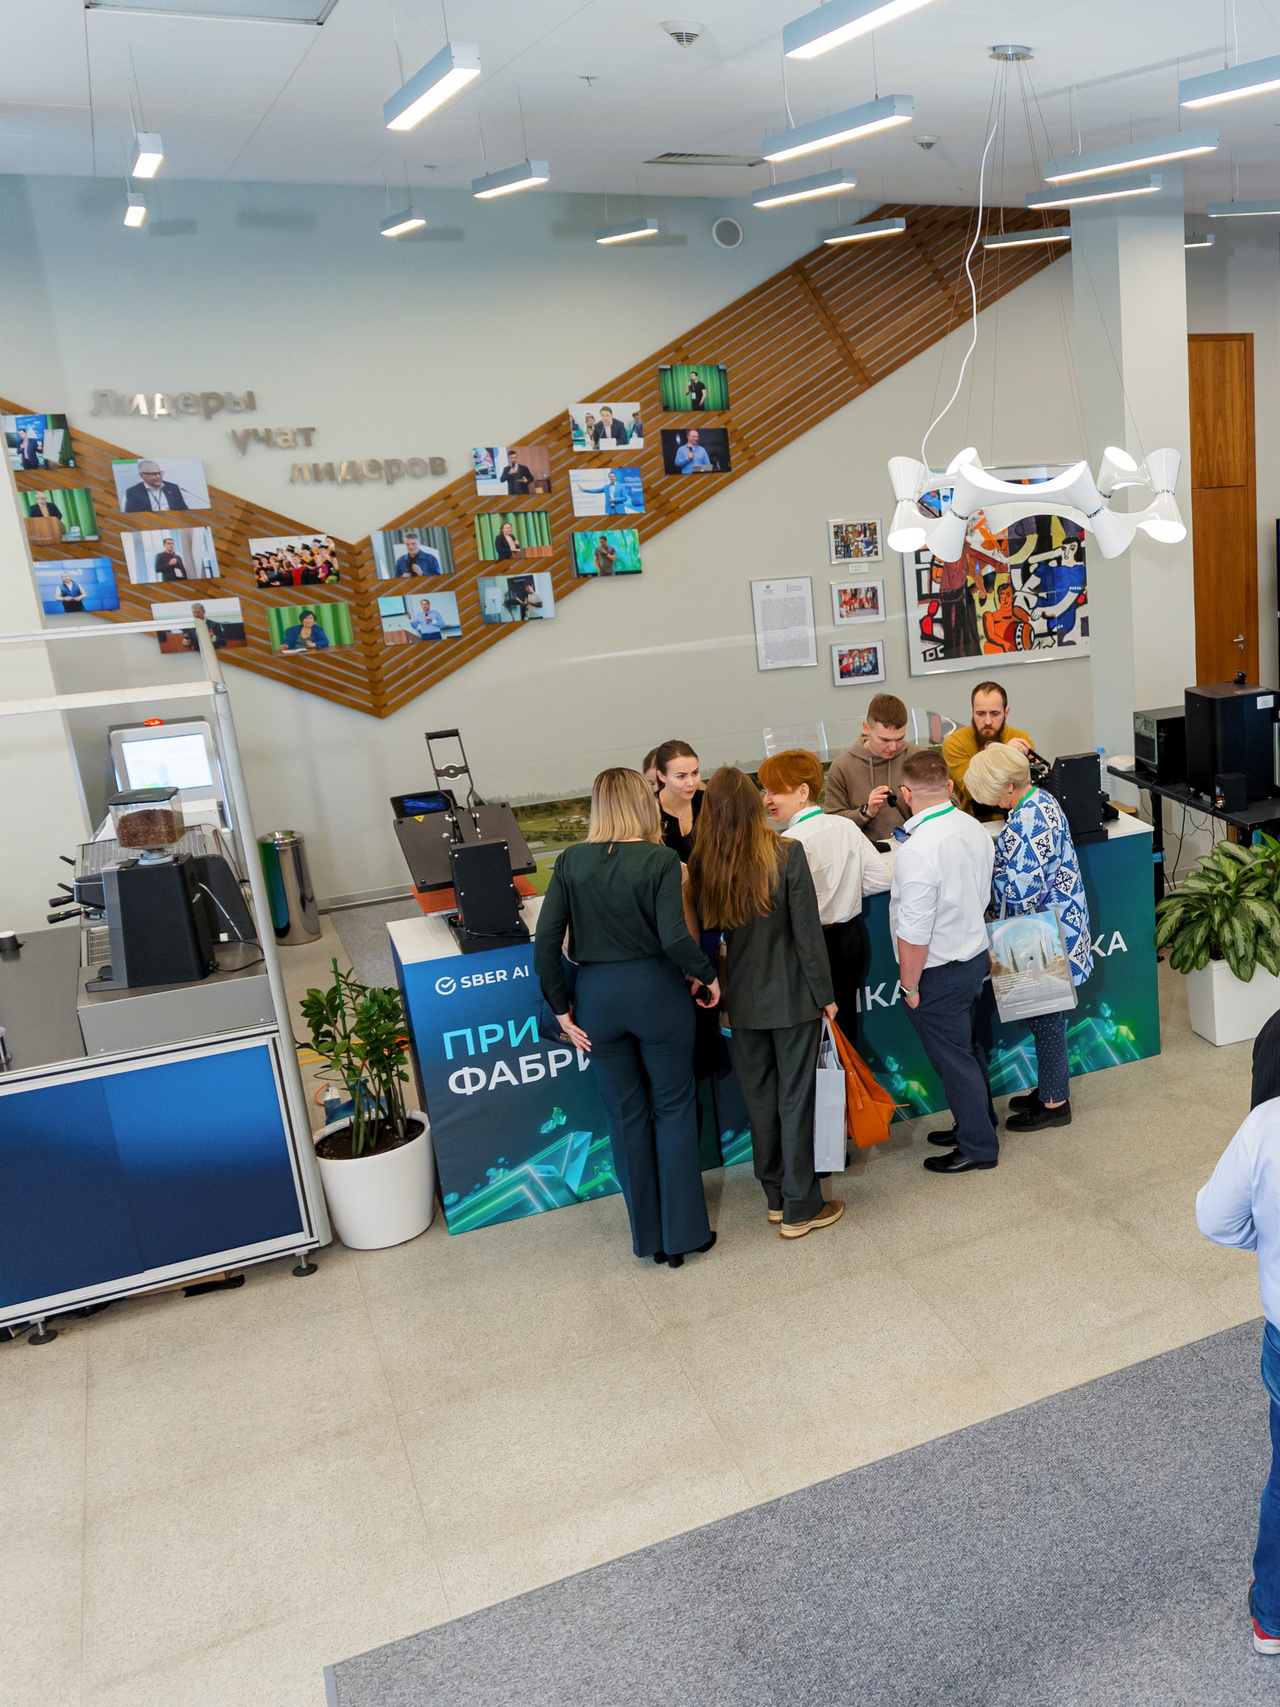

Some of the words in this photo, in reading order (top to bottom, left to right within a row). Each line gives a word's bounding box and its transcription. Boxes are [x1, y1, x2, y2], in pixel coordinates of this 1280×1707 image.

[90, 388, 257, 420] Лидеры
[227, 426, 316, 456] учат
[289, 456, 448, 485] лидеров
[460, 969, 508, 989] SBER
[512, 965, 530, 980] AI
[442, 1015, 540, 1060] ПРИ
